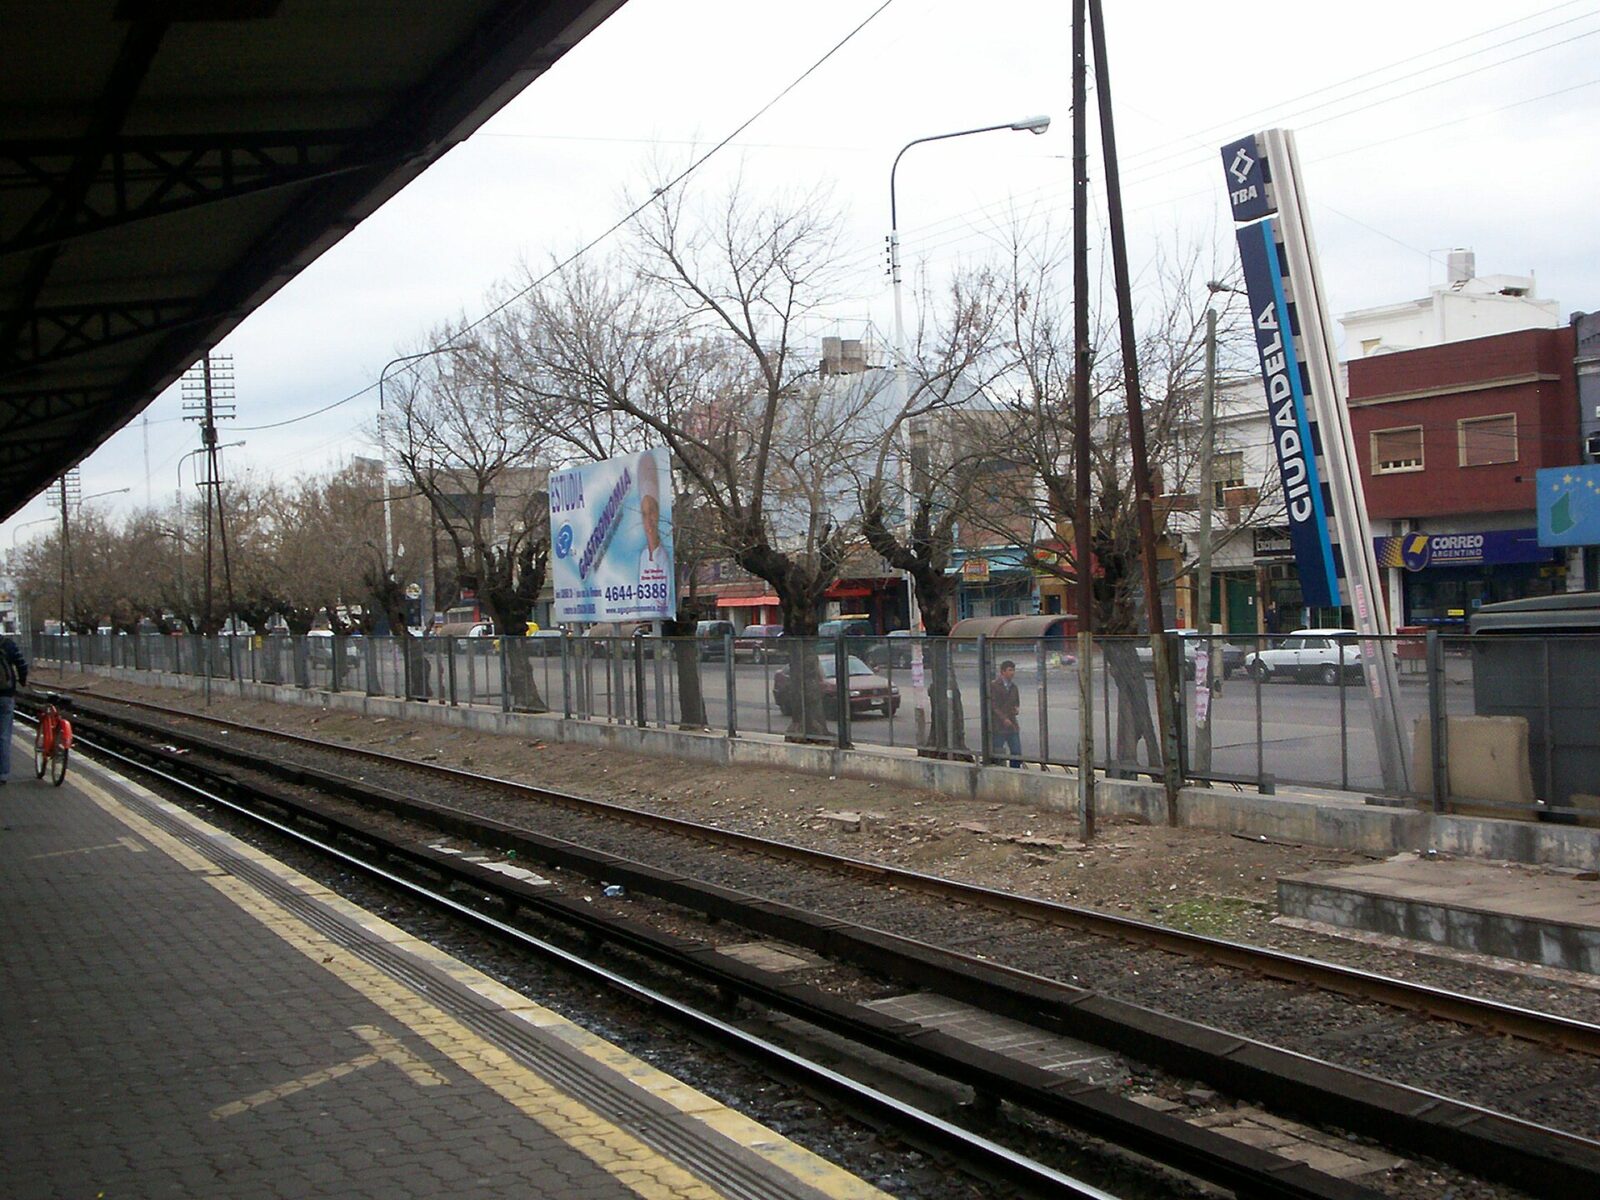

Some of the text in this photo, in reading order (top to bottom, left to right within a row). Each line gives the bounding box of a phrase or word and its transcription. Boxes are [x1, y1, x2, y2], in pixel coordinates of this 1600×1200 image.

[1231, 185, 1258, 206] TBA
[1257, 301, 1313, 522] CIUDADELA
[551, 472, 585, 513] ESTUDIA
[579, 467, 632, 580] GASTRONOMIA
[1431, 534, 1484, 550] CORREO
[1431, 548, 1483, 557] ARGENTINO
[605, 583, 668, 601] 4644-6388
